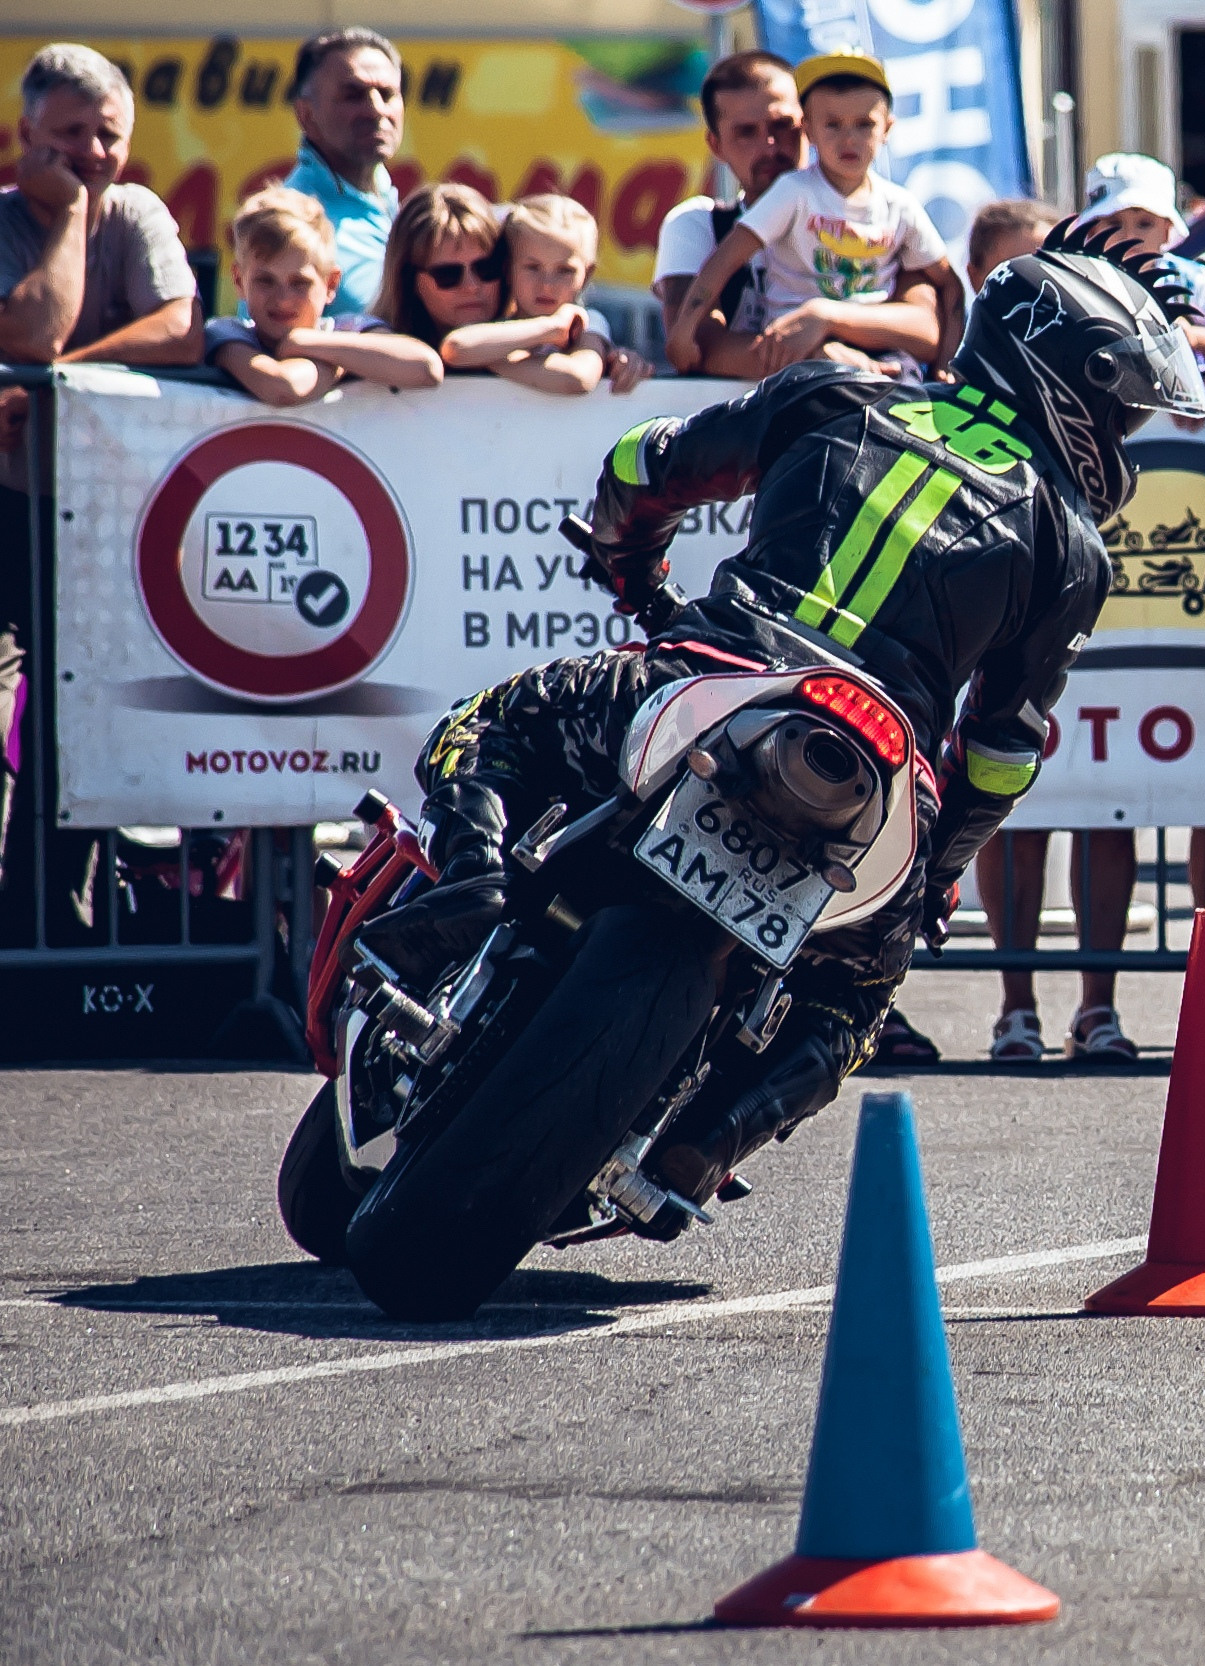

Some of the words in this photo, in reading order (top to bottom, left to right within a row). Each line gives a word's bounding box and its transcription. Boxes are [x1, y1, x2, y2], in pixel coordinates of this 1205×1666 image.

[888, 401, 1032, 475] 46
[216, 521, 258, 556] 12
[263, 523, 309, 557] 34
[463, 555, 523, 591] НА
[464, 611, 490, 647] В
[506, 611, 631, 648] МРЭО
[185, 749, 381, 775] MOTOVOZ.RU
[694, 800, 810, 892] 6807
[737, 867, 778, 904] RUS
[731, 888, 790, 950] 78
